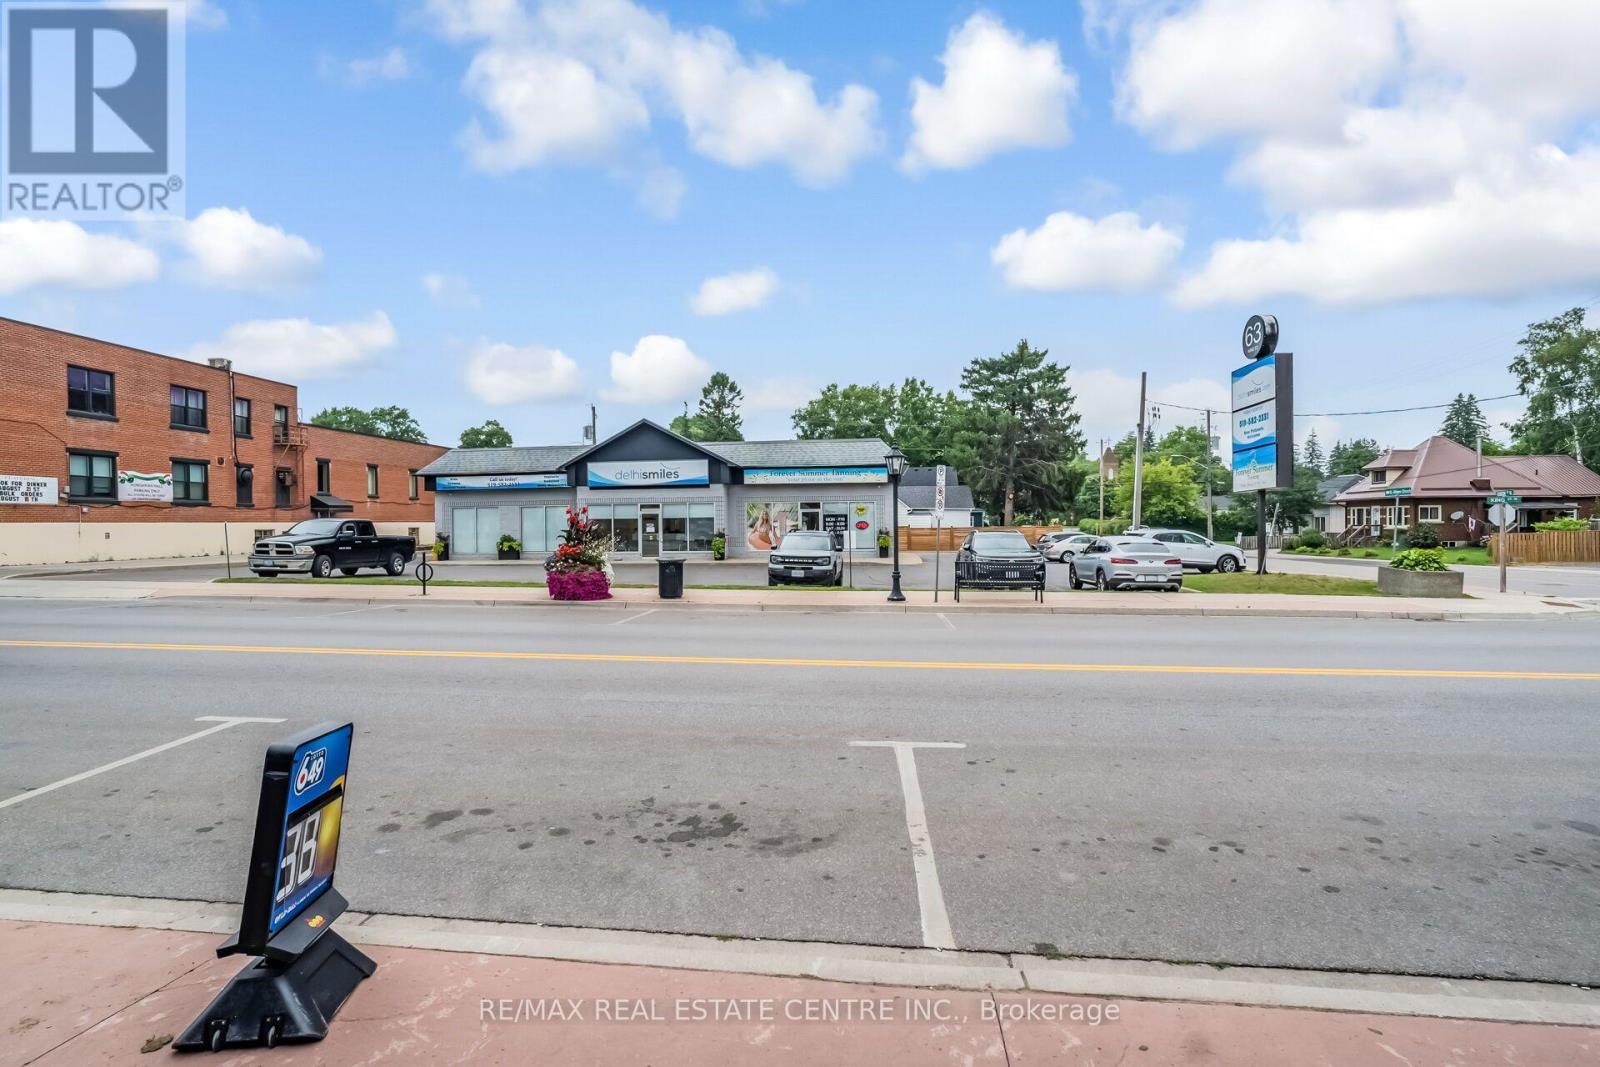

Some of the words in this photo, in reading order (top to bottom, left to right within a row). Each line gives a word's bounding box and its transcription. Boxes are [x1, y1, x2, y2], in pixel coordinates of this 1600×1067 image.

[1245, 322, 1261, 347] 63
[615, 469, 680, 480] delhismiles
[832, 469, 861, 477] Tanning
